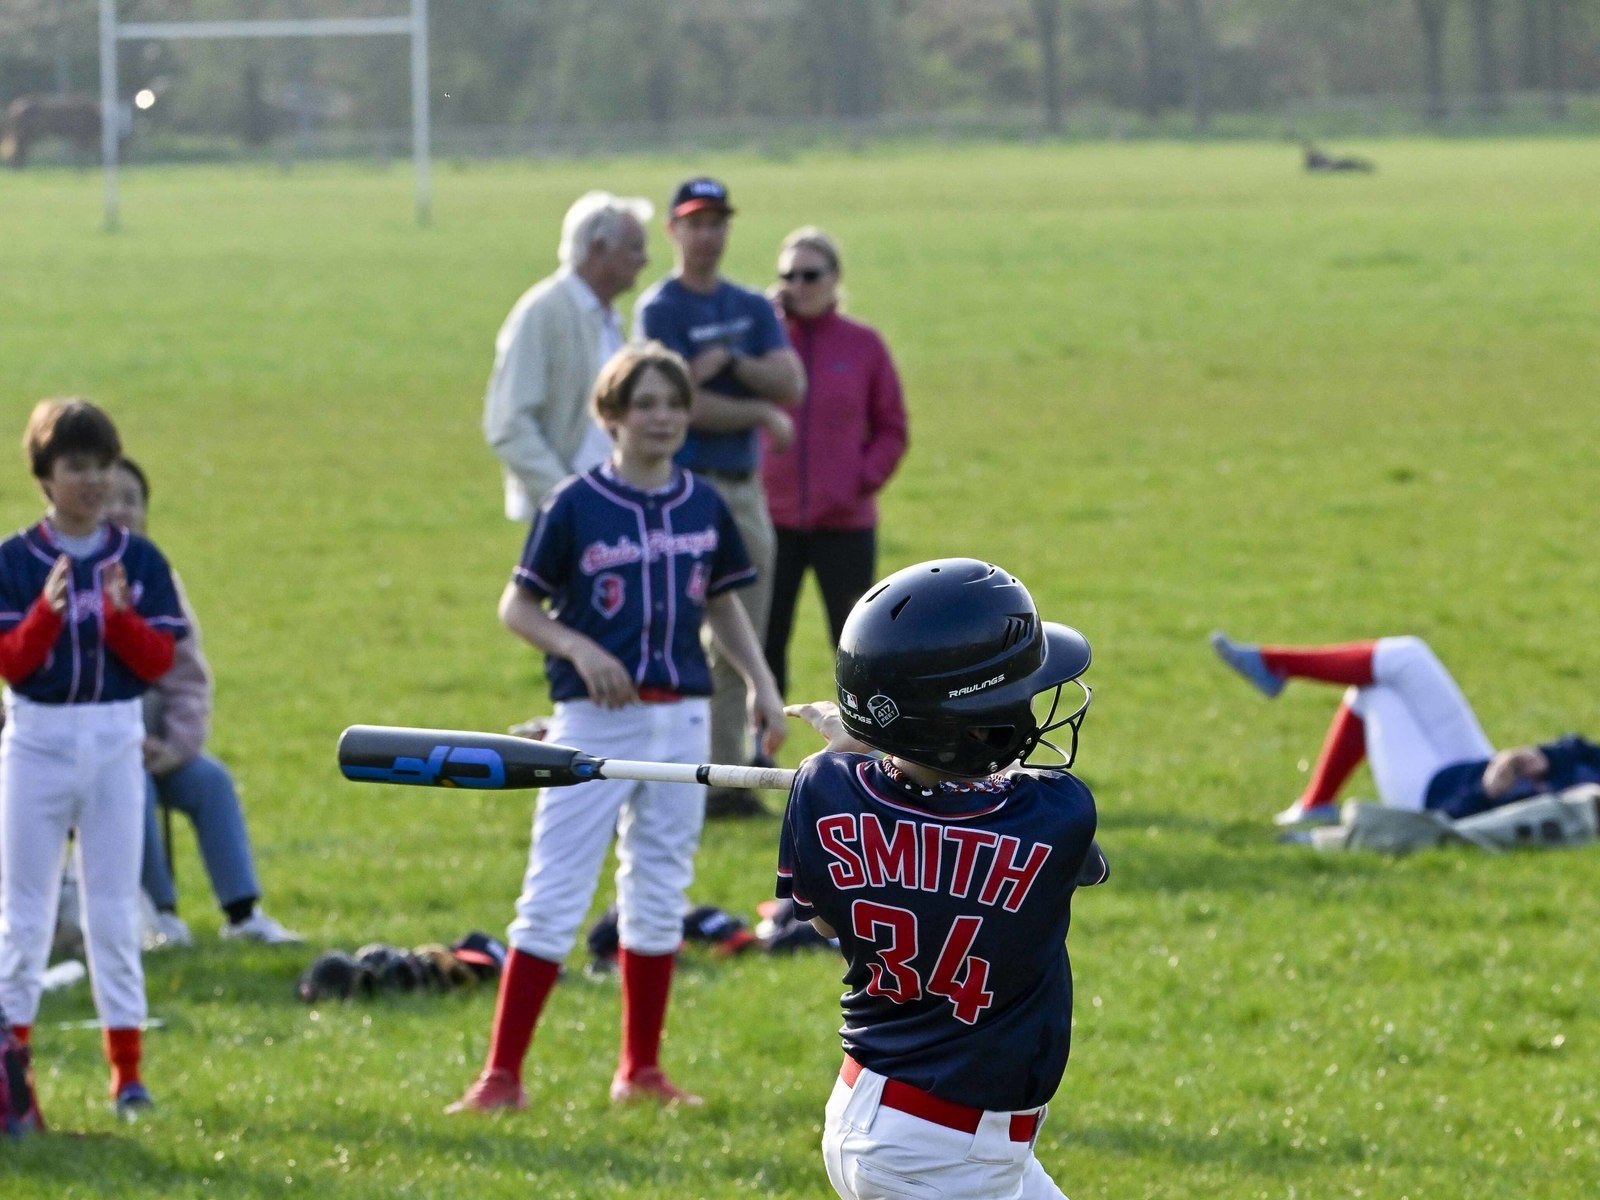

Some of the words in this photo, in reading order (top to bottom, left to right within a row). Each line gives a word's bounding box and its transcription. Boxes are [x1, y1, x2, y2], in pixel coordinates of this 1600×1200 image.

[877, 704, 891, 718] 417
[949, 673, 1005, 698] RAWLINGS
[816, 812, 1052, 913] SMITH
[851, 899, 994, 1025] 34
